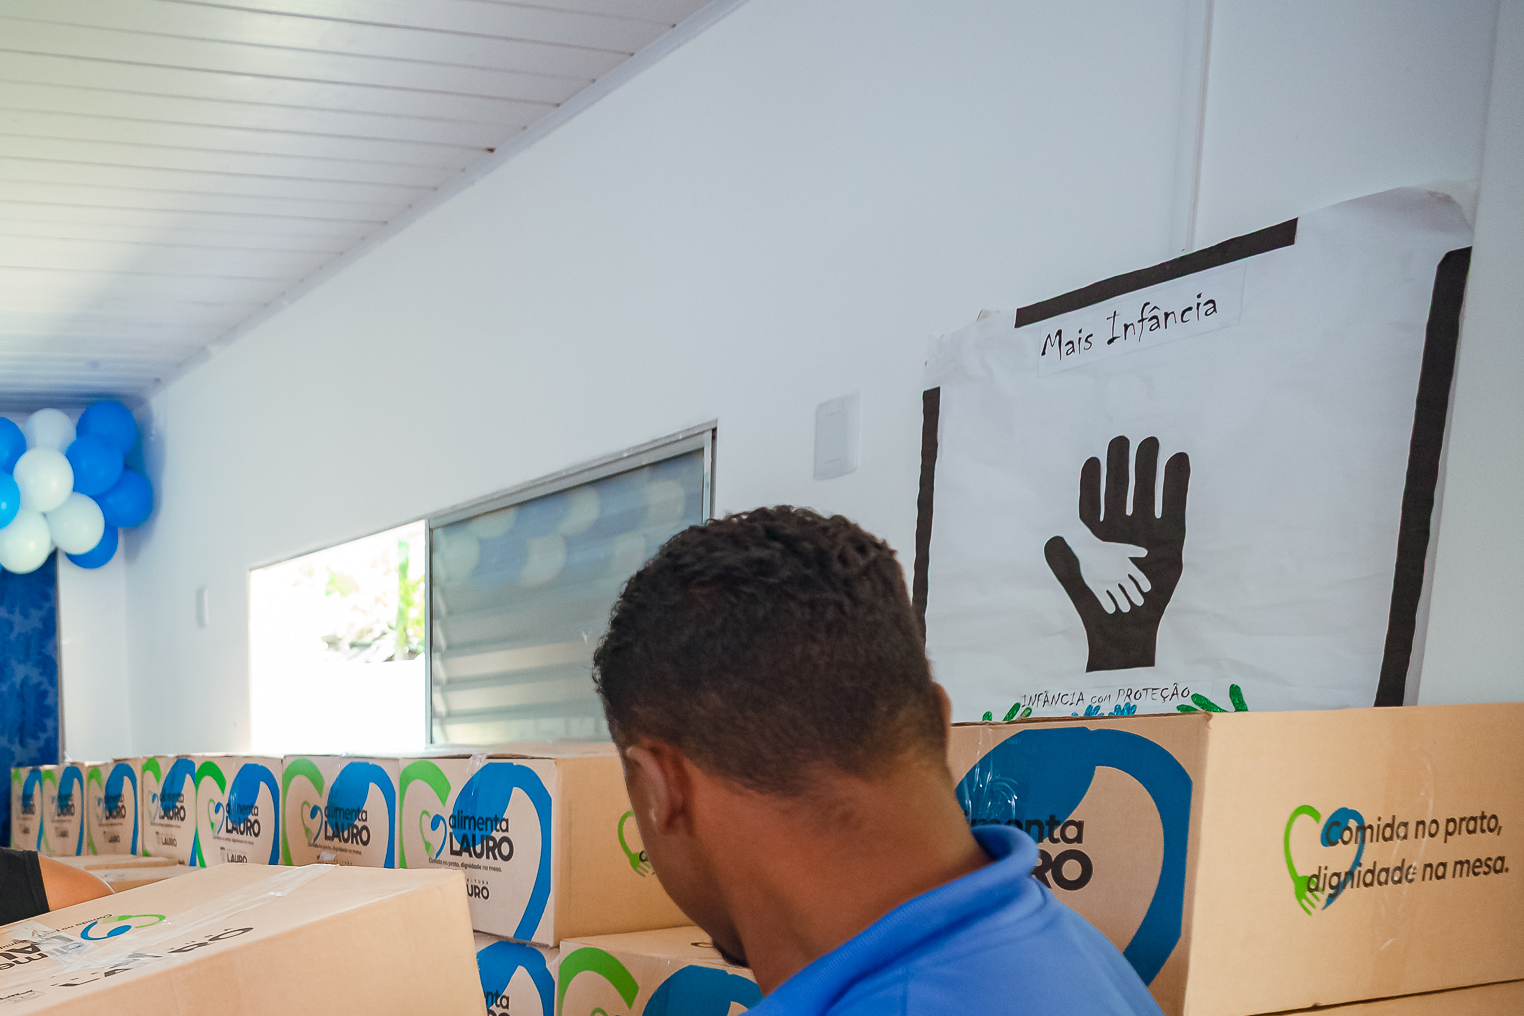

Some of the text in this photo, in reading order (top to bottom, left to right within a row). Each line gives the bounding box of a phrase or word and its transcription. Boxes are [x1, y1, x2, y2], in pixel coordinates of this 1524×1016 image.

[1041, 292, 1218, 360] Mais Infância
[1021, 690, 1085, 708] INFÂNCIA
[1116, 682, 1191, 703] PROTEÇÃO
[324, 804, 368, 823] alimenta
[448, 809, 510, 834] alimenta
[226, 818, 261, 838] LAURO
[324, 820, 371, 847] LAURO
[1325, 810, 1503, 848] Comida no prato,
[449, 832, 514, 862] LAURO
[1307, 853, 1510, 899] dignidade na mesa.
[466, 883, 490, 900] URO
